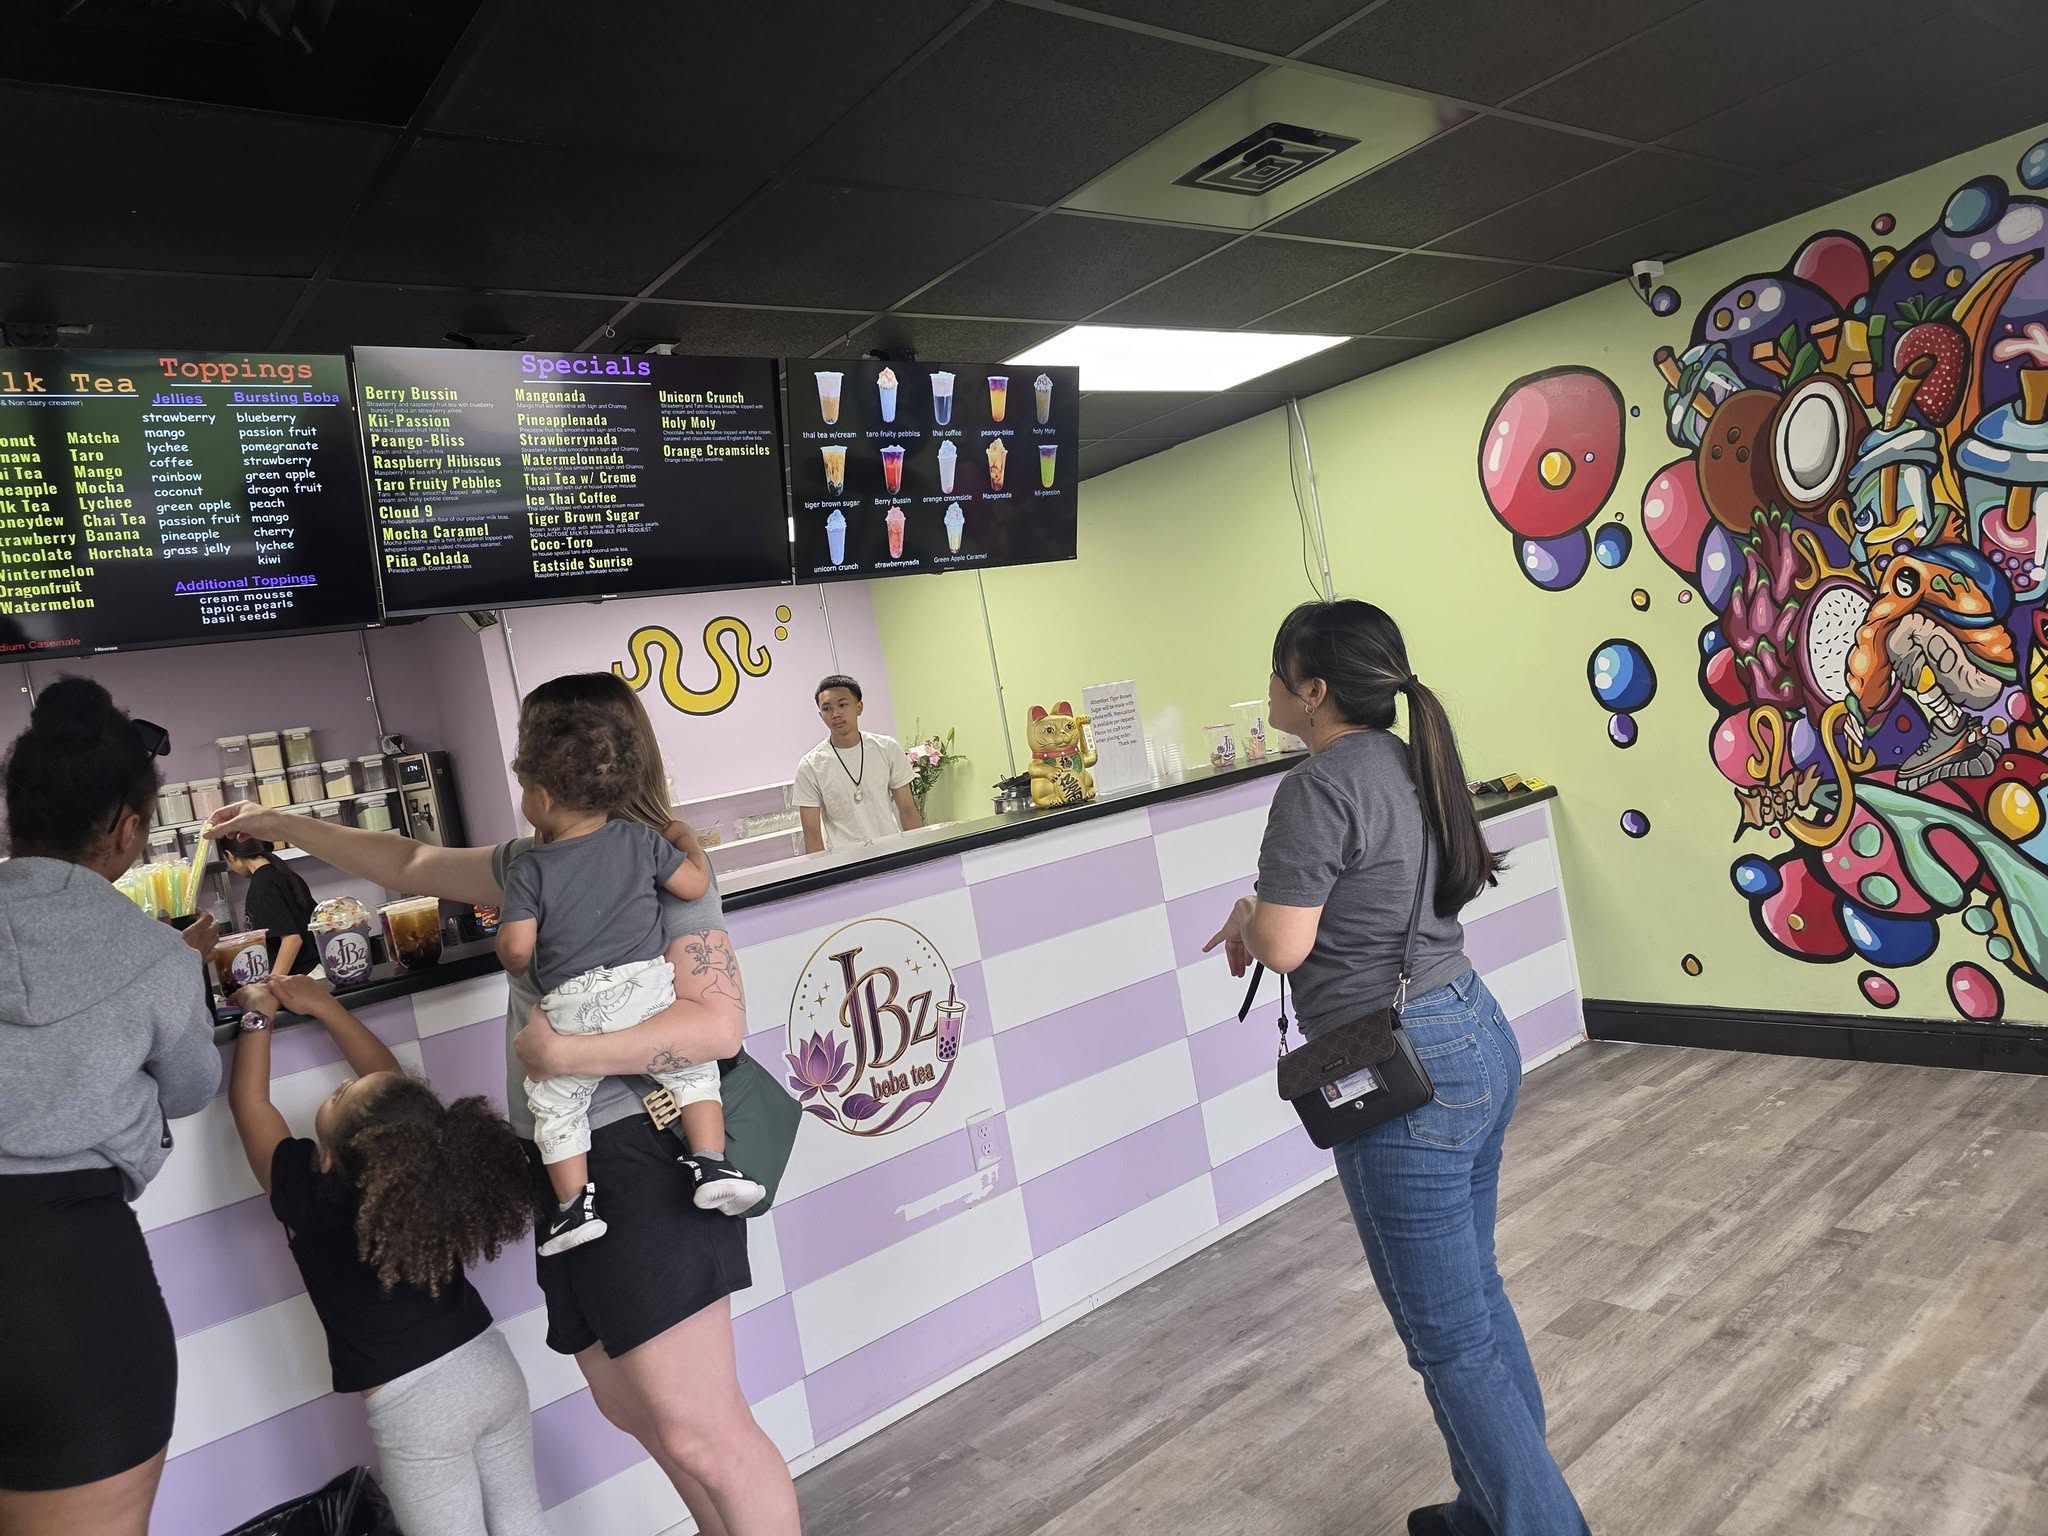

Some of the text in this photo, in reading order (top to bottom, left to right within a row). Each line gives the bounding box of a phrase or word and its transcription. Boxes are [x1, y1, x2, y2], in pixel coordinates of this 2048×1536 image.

[159, 357, 313, 383] Toppings
[521, 353, 651, 379] Specials
[70, 373, 137, 392] Tea
[152, 393, 204, 404] Jellies
[233, 391, 340, 407] Bursting Boba
[364, 386, 458, 402] Berry Bussin
[514, 388, 586, 404] Mangonada
[659, 390, 745, 404] Unicorn Crunch
[27, 399, 47, 409] dairy
[48, 399, 84, 407] creamer)
[142, 411, 216, 425] strawberry
[236, 411, 297, 425] blueberry
[367, 413, 451, 428] Kii-Passion
[517, 413, 608, 428] Pineapplenada
[661, 416, 716, 430] Holy Moly
[66, 431, 120, 445] Matcha
[144, 428, 186, 440] mango
[238, 425, 317, 440] passion fruit
[802, 431, 816, 439] thai
[829, 431, 857, 439] w/cream
[866, 430, 921, 438] taro fruity pebbles
[932, 429, 962, 437] thai coffee
[980, 429, 1015, 438] peango-bliss
[1044, 427, 1056, 435] Moly
[241, 440, 319, 454] pomegranate
[370, 433, 465, 449] Peango-Bliss
[519, 433, 618, 448] Strawberrynada
[69, 448, 104, 462] Taro
[146, 442, 189, 456] lychee
[663, 443, 771, 458] Orange Creamsicles
[149, 456, 194, 468] coffee
[243, 454, 312, 467] strawberry
[373, 454, 502, 470] Raspberry Hibiscus
[520, 452, 624, 466] Watermelonnada
[14, 466, 43, 480] Tea
[73, 465, 123, 480] Mango
[151, 471, 203, 483] rainbow
[245, 468, 316, 483] green apple
[522, 471, 637, 486] Thai Tea w/ Creme
[75, 481, 125, 495] Mocha
[154, 485, 204, 497] coconut
[247, 483, 323, 497] dragon fruit
[374, 476, 502, 492] Taro Fruity Pebbles
[525, 491, 617, 506] Ice Thai Coffee
[922, 494, 973, 504] orange creamsicle
[982, 492, 1012, 500] Mangonada
[1034, 489, 1061, 497] kii-passion
[21, 499, 50, 513] Tea
[79, 496, 132, 512] Lychee
[156, 499, 232, 515] green apple
[249, 498, 285, 511] peach
[804, 499, 861, 510] tiger brown sugar
[874, 496, 912, 506] Berry Bussin
[379, 504, 433, 519] Cloud 9
[527, 509, 640, 527] Tiger Brown Sugar
[83, 512, 146, 528] Chai Tea
[159, 513, 241, 530] passion fruit
[251, 513, 289, 525] mango
[85, 529, 140, 543] Banana
[160, 528, 220, 545] pineapple
[253, 526, 295, 538] cherry
[382, 523, 489, 541] Mocha Caramel
[163, 542, 231, 559] grass jelly
[255, 540, 295, 551] lychee
[530, 537, 594, 551] Coco-Toro
[88, 545, 153, 560] Horchata
[257, 553, 281, 565] kiwi
[385, 550, 470, 568] Piña Colada
[933, 553, 988, 563] Green Apple Caramel
[533, 556, 634, 573] Eastside Sunrise
[814, 563, 859, 573] unicorn crunch
[874, 560, 920, 569] strawberrynada
[175, 572, 317, 592] Additional Toppings
[0, 580, 82, 599] Dragonfruit
[199, 590, 294, 604] cream mousse
[0, 596, 95, 614] Watermelon
[200, 599, 294, 616] tapioca pearls
[202, 610, 278, 625] basil seeds
[29, 637, 81, 650] Caseinate
[870, 1063, 935, 1101] boba tea
